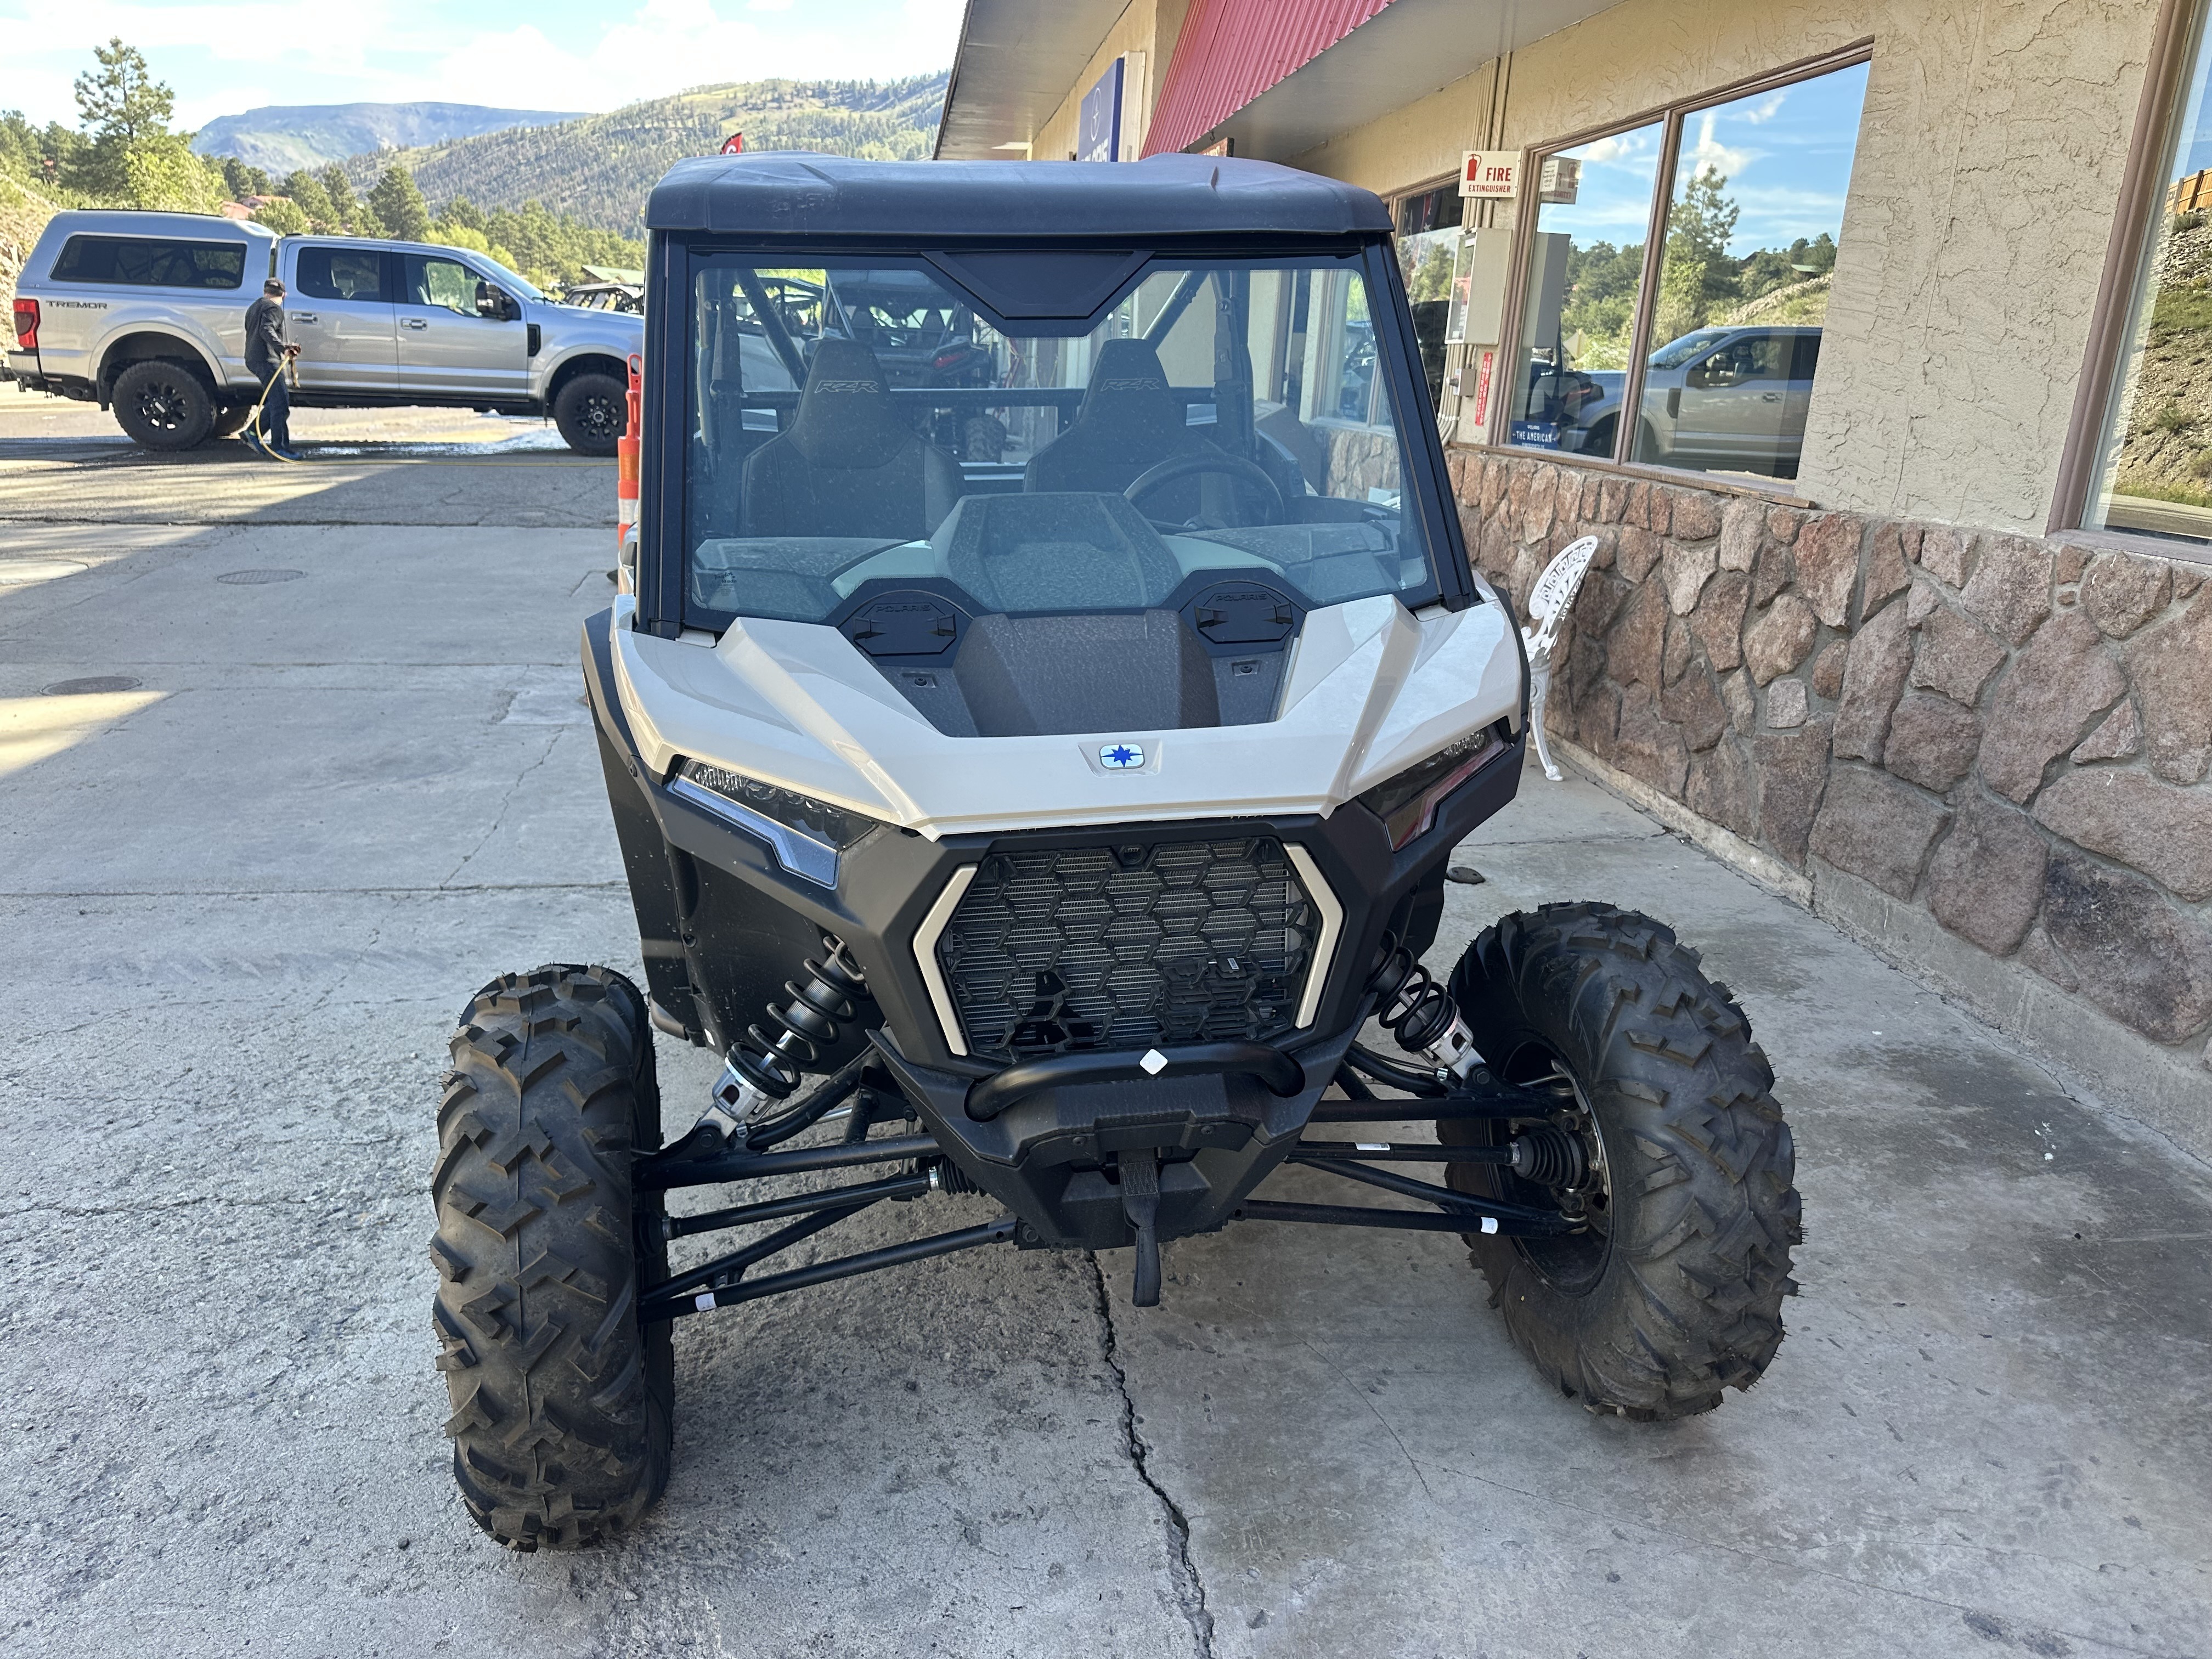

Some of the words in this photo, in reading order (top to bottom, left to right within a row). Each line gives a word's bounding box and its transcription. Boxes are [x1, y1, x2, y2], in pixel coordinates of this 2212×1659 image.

[1486, 167, 1512, 182] FIRE
[1468, 184, 1511, 193] EXTINGUISHER
[46, 300, 108, 309] TREMOR
[814, 380, 878, 393] RZR
[1100, 377, 1160, 392] RZR
[1516, 431, 1526, 440] THE
[1527, 432, 1552, 443] AMERICAN
[1216, 594, 1267, 602] POLARIS
[876, 605, 931, 613] POLARIS
